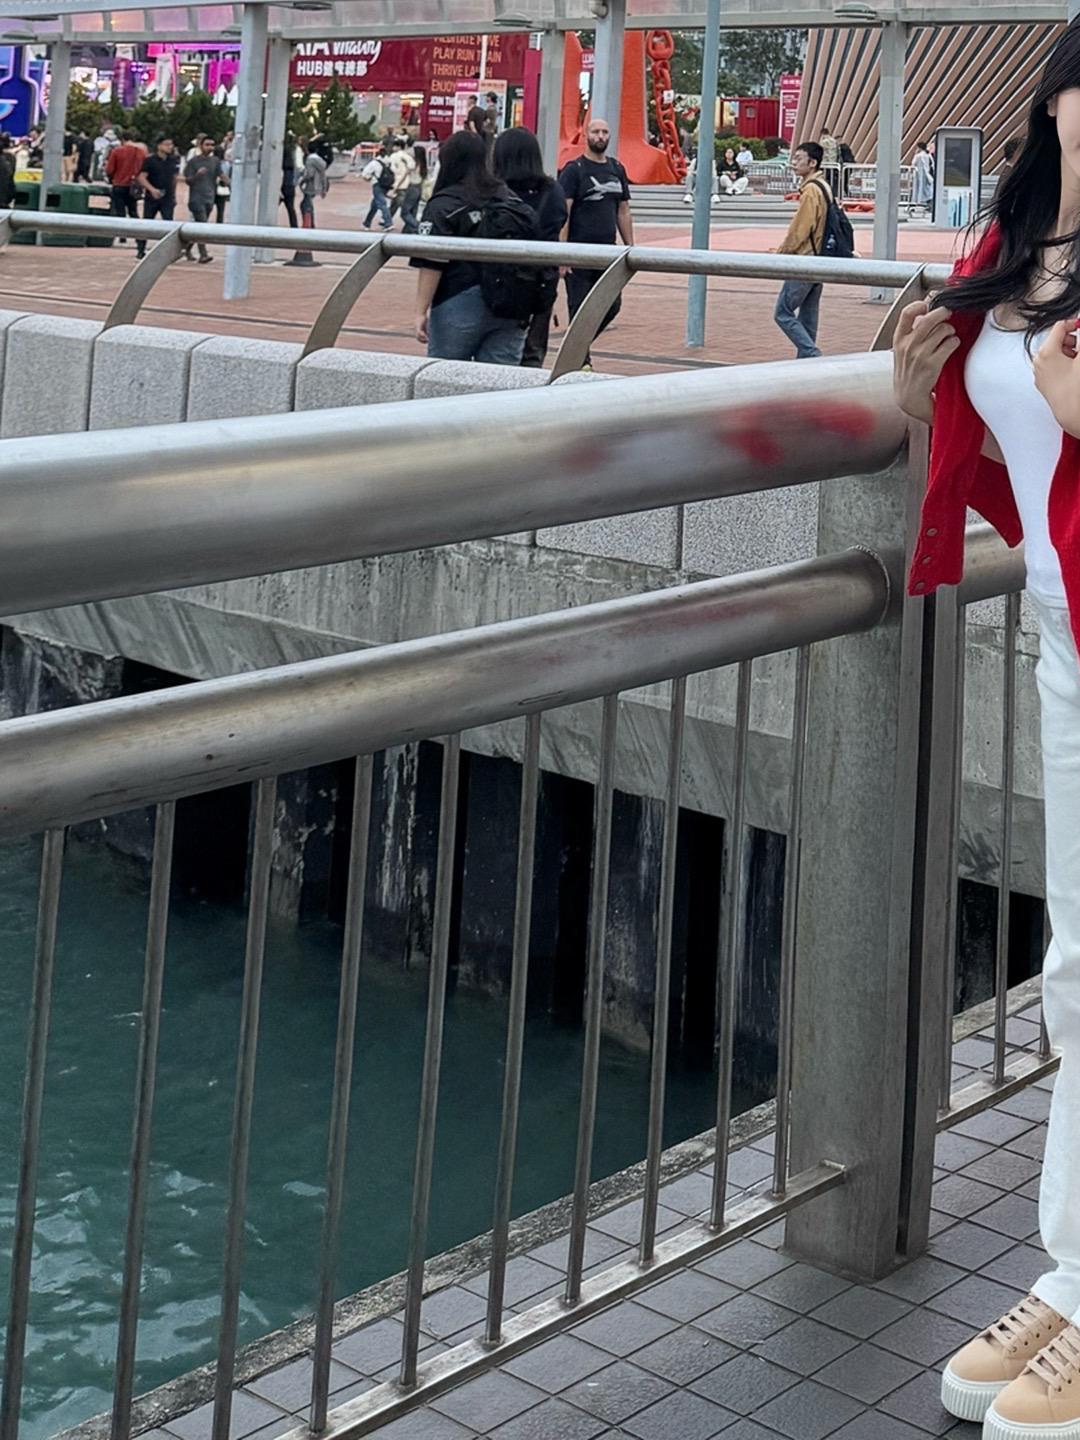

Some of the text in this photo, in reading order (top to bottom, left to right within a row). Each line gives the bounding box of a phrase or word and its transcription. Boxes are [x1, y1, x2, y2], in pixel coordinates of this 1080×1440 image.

[433, 47, 502, 63] PLAY RUN TAIN
[432, 63, 463, 77] THRIVE
